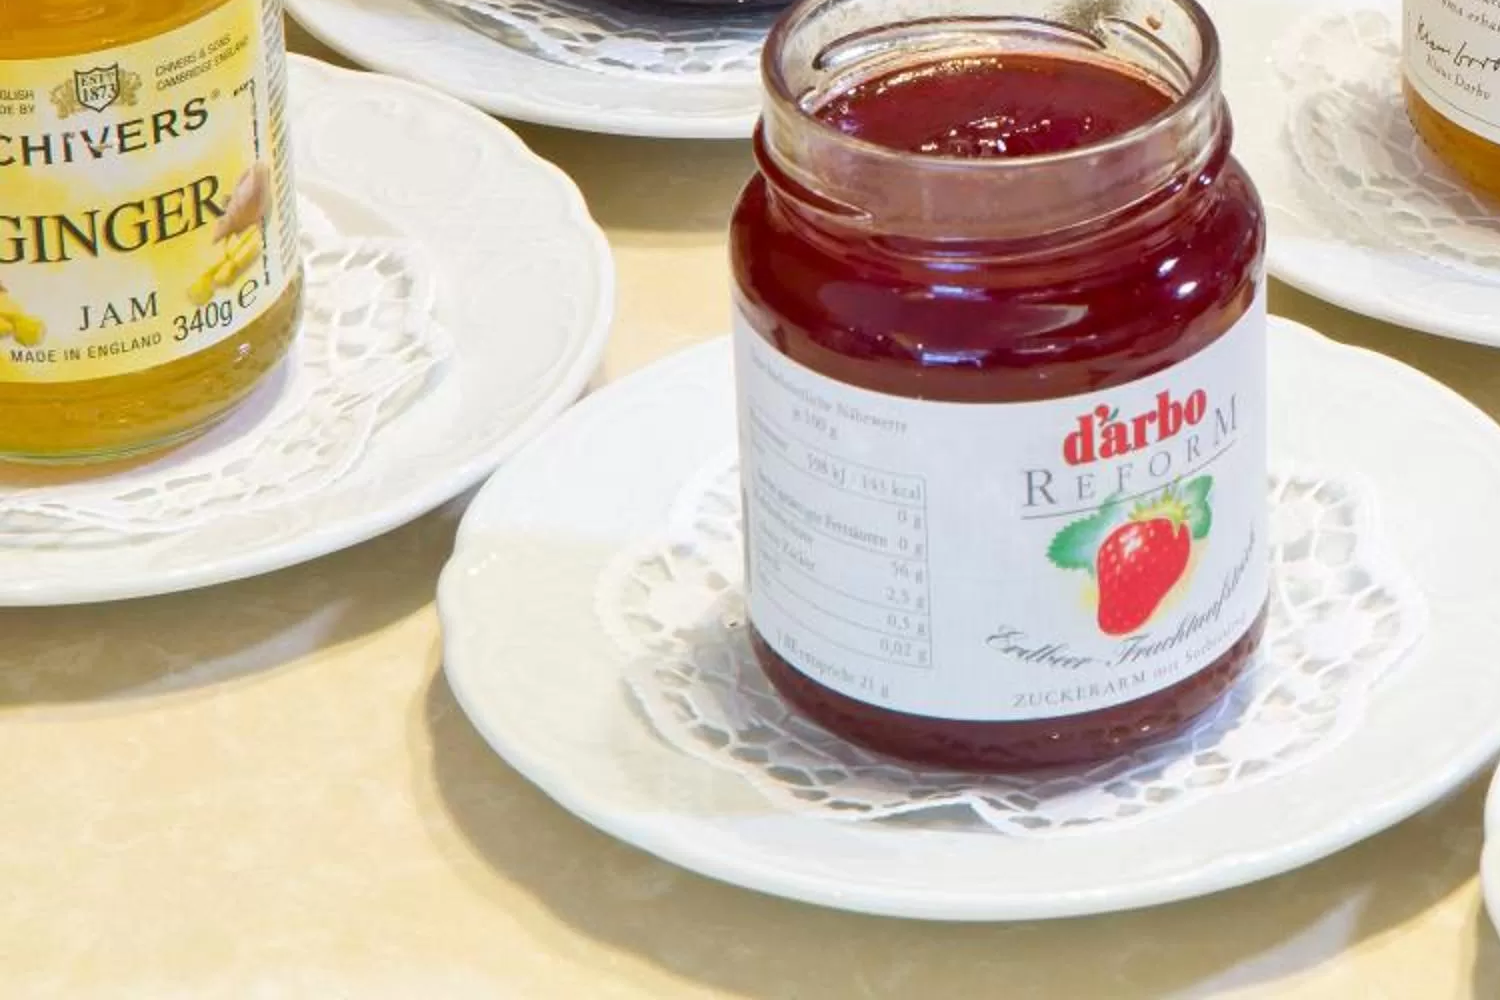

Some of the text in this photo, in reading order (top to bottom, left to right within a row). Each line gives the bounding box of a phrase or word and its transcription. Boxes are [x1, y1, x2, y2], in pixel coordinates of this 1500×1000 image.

[0, 175, 227, 265] GINGER
[79, 291, 160, 332] JAM
[172, 299, 234, 342] 340g
[10, 331, 162, 364] MADE IN ENGLAND
[1022, 392, 1238, 507] REFORM
